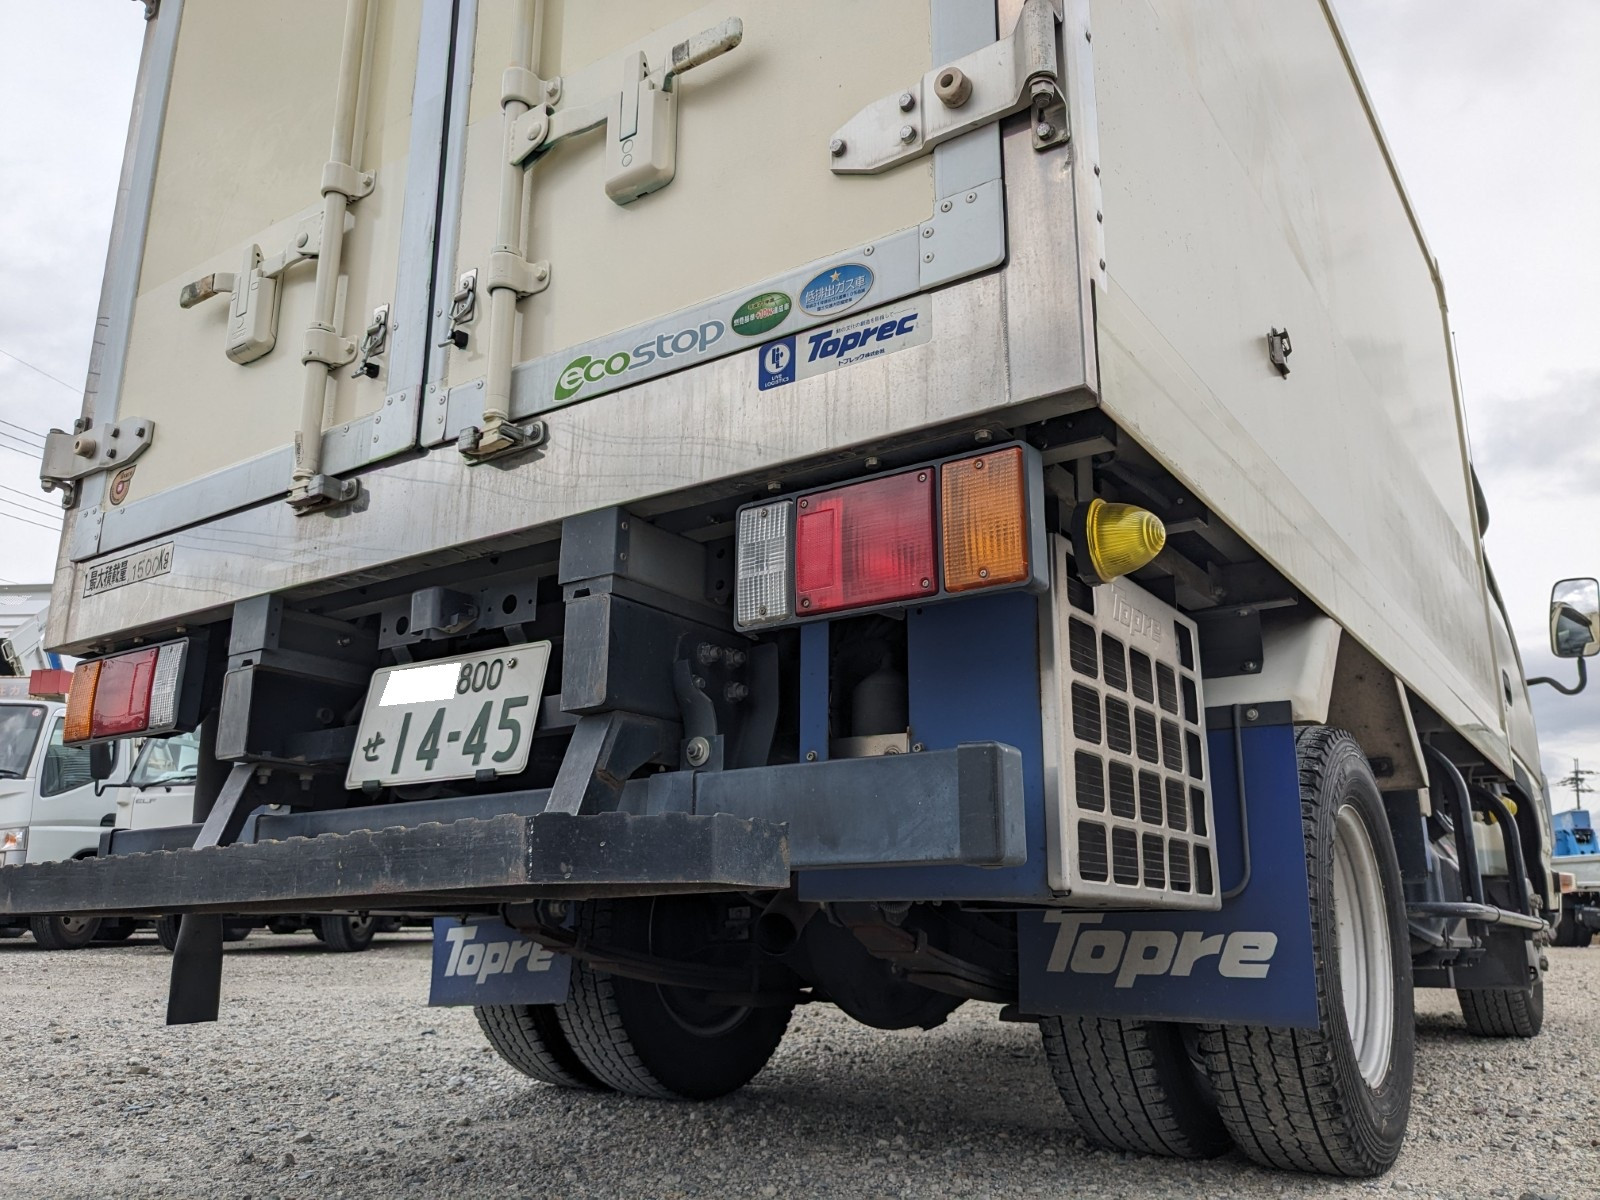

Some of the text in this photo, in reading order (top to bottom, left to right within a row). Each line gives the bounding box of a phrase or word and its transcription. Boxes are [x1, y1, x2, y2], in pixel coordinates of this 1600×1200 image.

[805, 275, 866, 304] 低排出ガス車
[555, 320, 725, 400] ecostop
[807, 313, 919, 363] Toprec
[89, 560, 128, 592] 最大積載量
[456, 658, 504, 695] 800
[362, 695, 530, 775] せ 14-45
[444, 926, 554, 985] Topre
[1042, 909, 1278, 988] Topre
